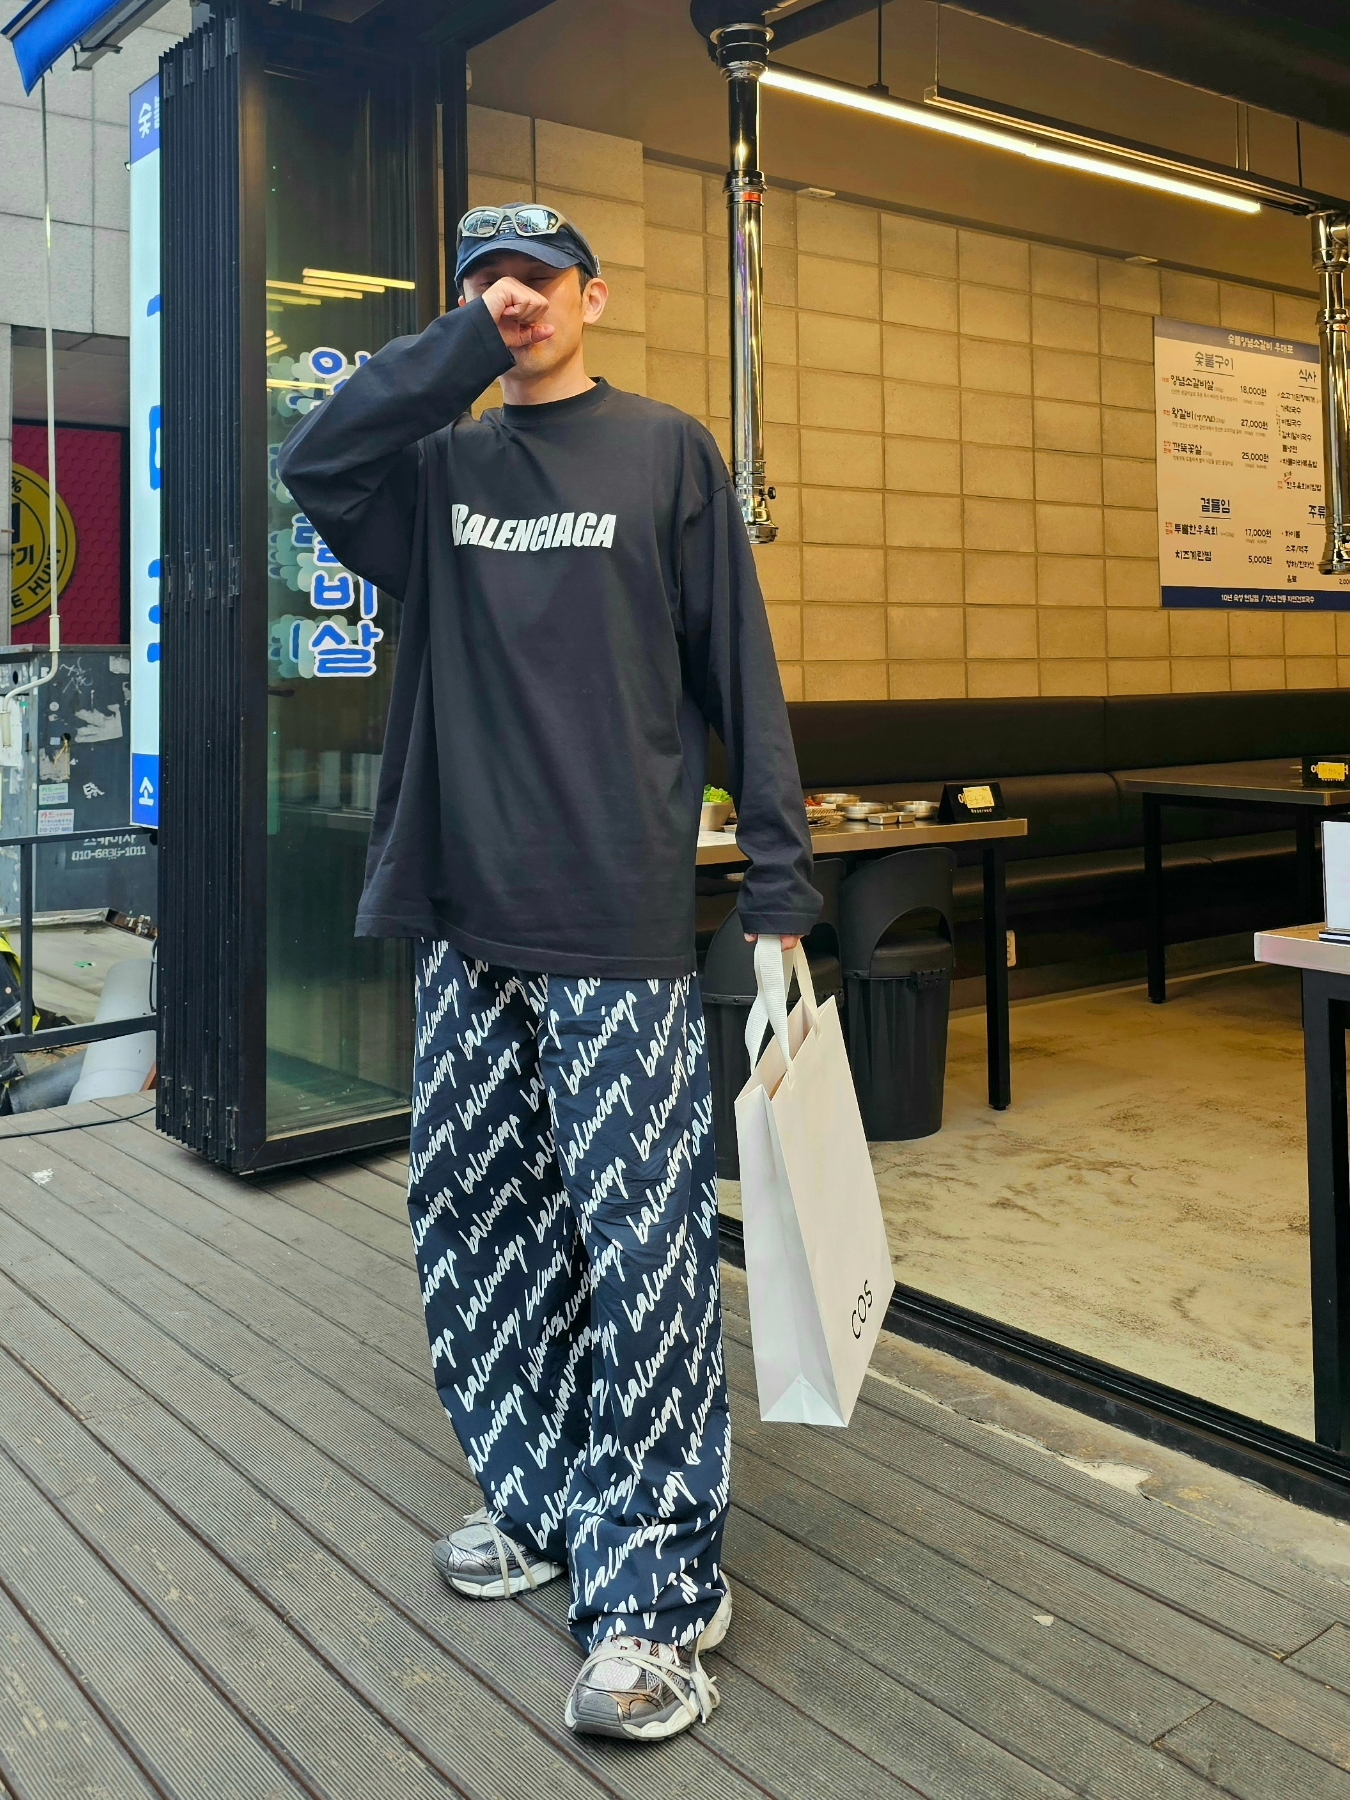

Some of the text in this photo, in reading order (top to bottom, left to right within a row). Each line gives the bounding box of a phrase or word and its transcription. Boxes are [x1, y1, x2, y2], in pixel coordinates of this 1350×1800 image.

[1195, 351, 1234, 371] 숯불구이
[1171, 375, 1214, 391] 양념소갈비살
[1241, 386, 1267, 397] 18,000원
[1298, 368, 1317, 383] 식사
[1172, 407, 1194, 420] 왕갈비
[1241, 419, 1268, 430] 27,000원
[1242, 452, 1269, 463] 25,000원
[1200, 498, 1231, 514] 곁들임
[1308, 505, 1325, 519] 주류
[452, 504, 617, 552] BALENCIAGA
[1245, 529, 1272, 539] 17,000원
[1285, 530, 1300, 539] 하이볼
[1175, 549, 1272, 565] 치즈계란찜 5,000원
[1221, 594, 1233, 602] 10년
[1265, 595, 1276, 603] 70년
[559, 991, 639, 1096] balenciaga
[455, 1041, 522, 1131] balenciaga
[559, 1073, 634, 1177] balenciaga
[454, 1114, 524, 1195] balenciaga
[458, 1177, 528, 1255] balenciaga
[456, 1235, 529, 1332] balenciaga
[851, 1279, 873, 1340] COS
